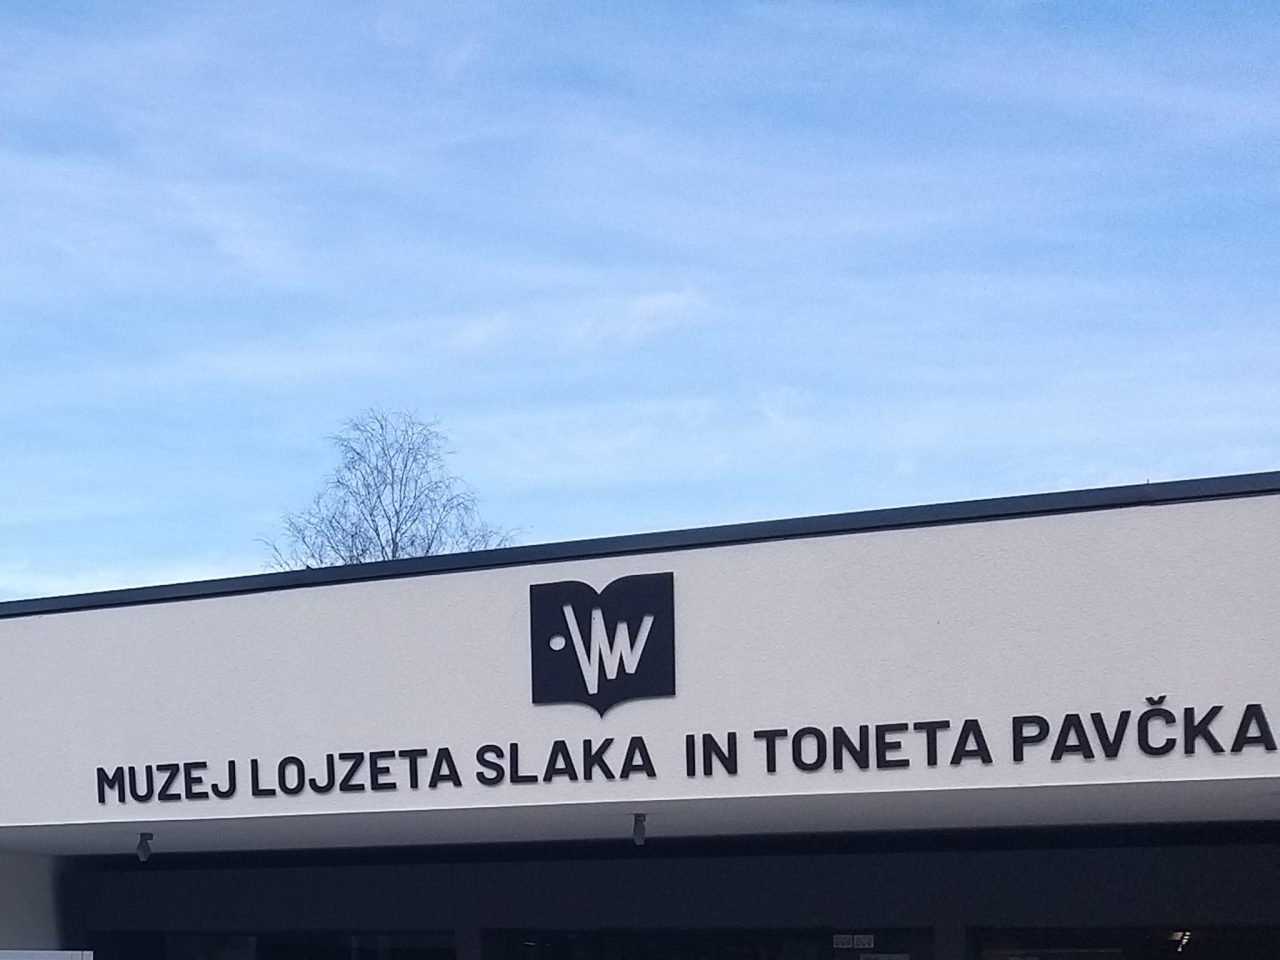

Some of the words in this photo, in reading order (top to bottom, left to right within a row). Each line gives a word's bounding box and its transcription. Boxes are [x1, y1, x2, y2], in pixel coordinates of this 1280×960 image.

[96, 759, 236, 803] MUZEJ
[250, 747, 463, 797] LOJZETA
[476, 735, 657, 786] SLAKA
[685, 731, 737, 777] IN
[753, 718, 993, 773] TONETA
[1012, 695, 1278, 762] PAVČKA
